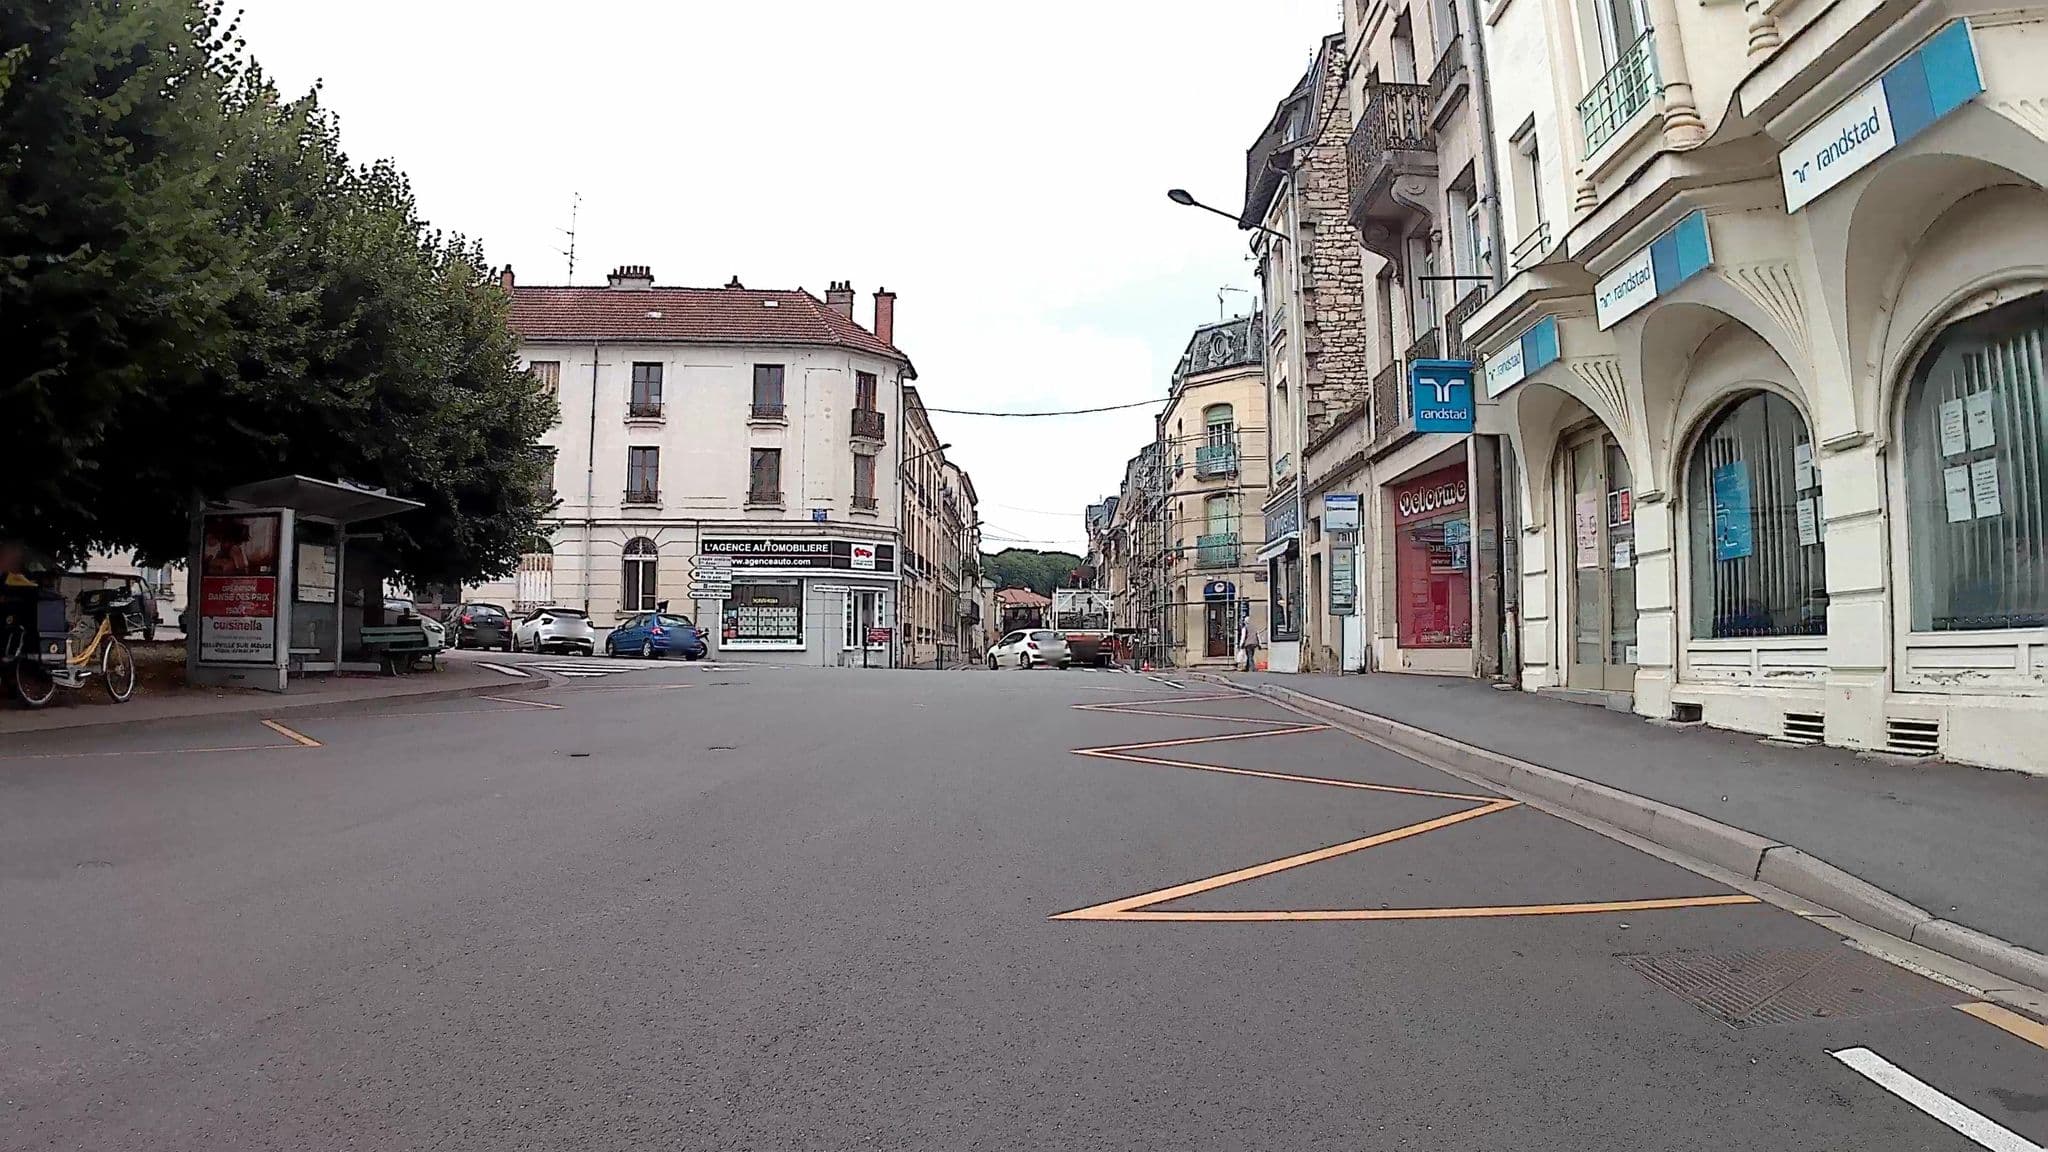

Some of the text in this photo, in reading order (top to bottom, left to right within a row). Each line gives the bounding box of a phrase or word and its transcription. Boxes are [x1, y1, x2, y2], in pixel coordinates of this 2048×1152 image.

[1816, 106, 1880, 171] randstad
[1613, 260, 1651, 300] randstad
[1420, 407, 1467, 420] randstad
[1399, 480, 1467, 517] Delorme
[704, 543, 829, 553] L'AGENCE AUTOMOBILIERE
[251, 592, 270, 601] PRIX
[213, 620, 263, 631] cuisinella
